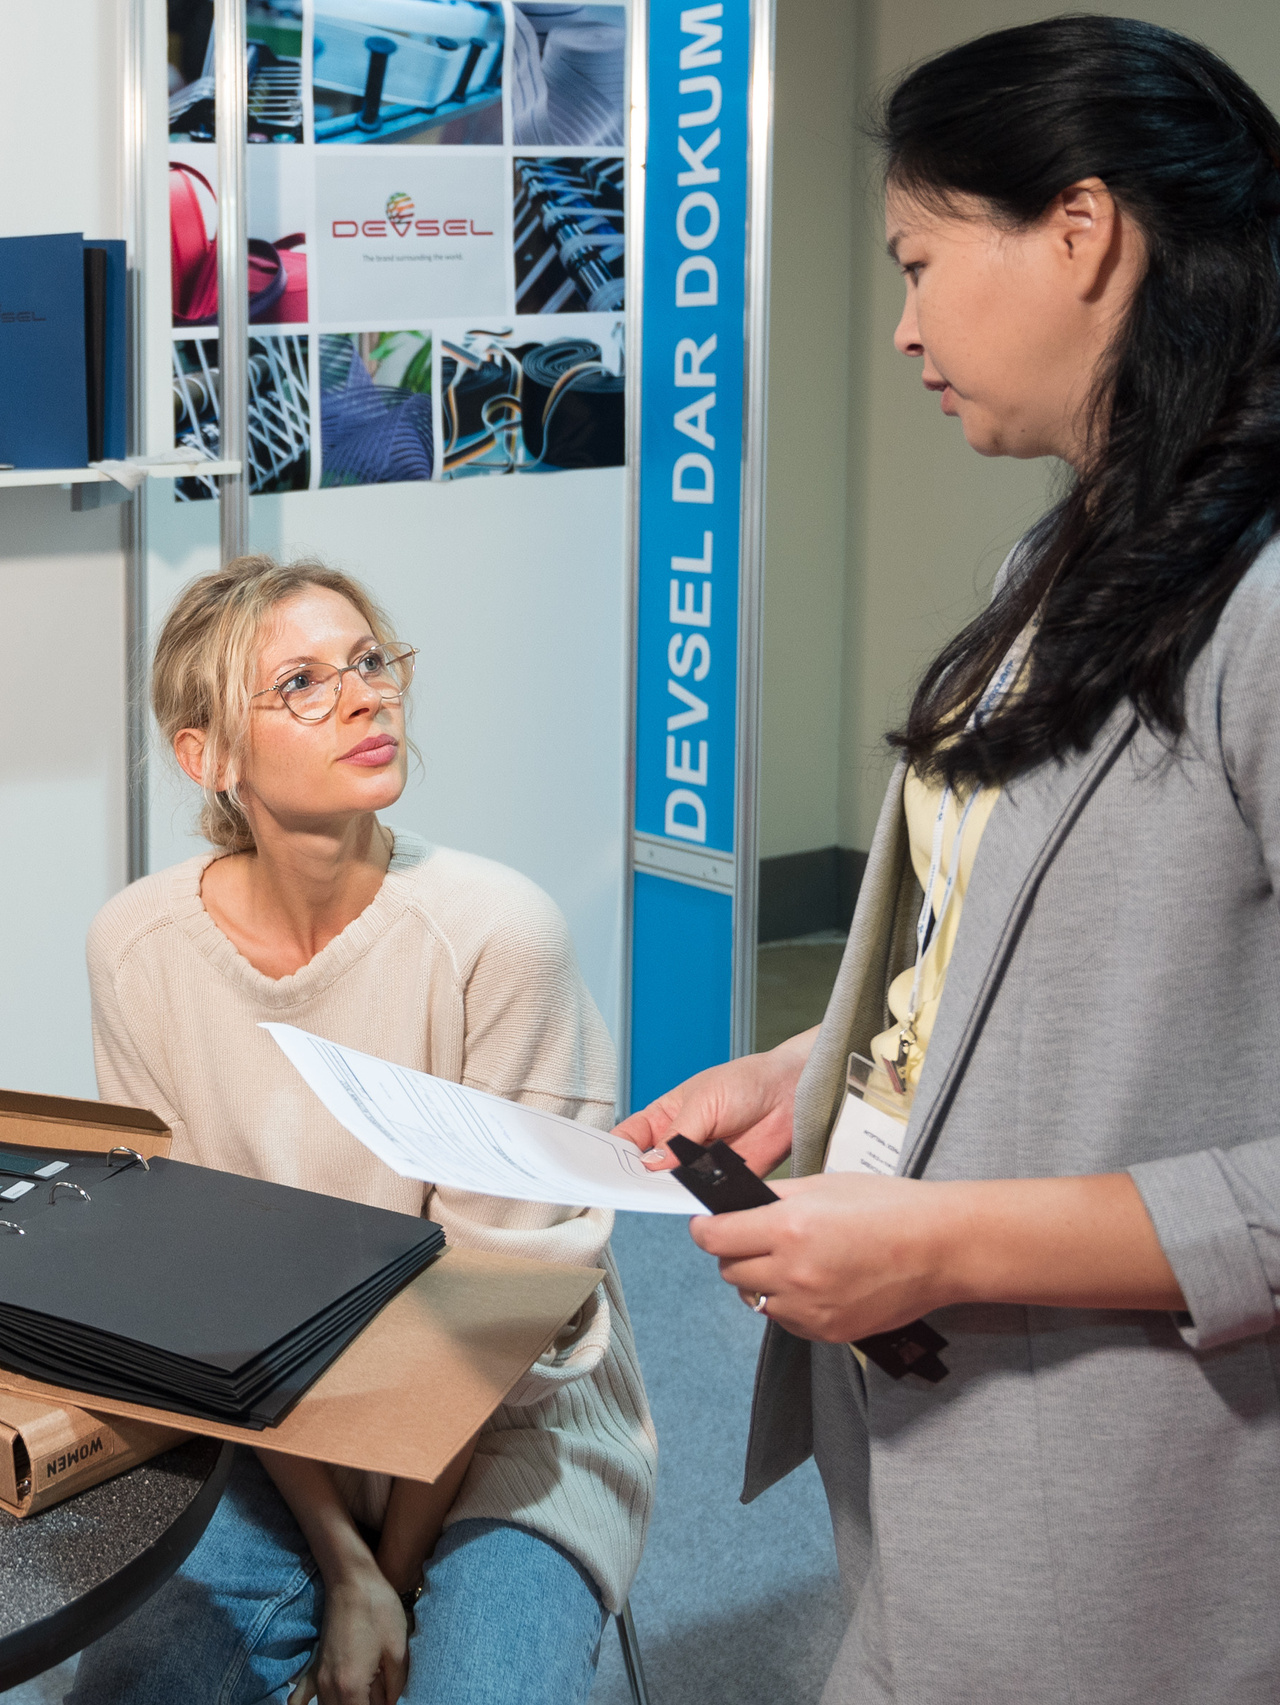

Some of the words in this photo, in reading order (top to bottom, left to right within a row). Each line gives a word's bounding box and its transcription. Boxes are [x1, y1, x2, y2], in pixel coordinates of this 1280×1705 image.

[675, 3, 724, 308] DOKUM
[332, 219, 494, 238] DEVSEL
[362, 254, 374, 262] The
[672, 332, 718, 504] DAR
[665, 530, 713, 844] DEVSEL
[46, 1436, 103, 1478] WOMEN
